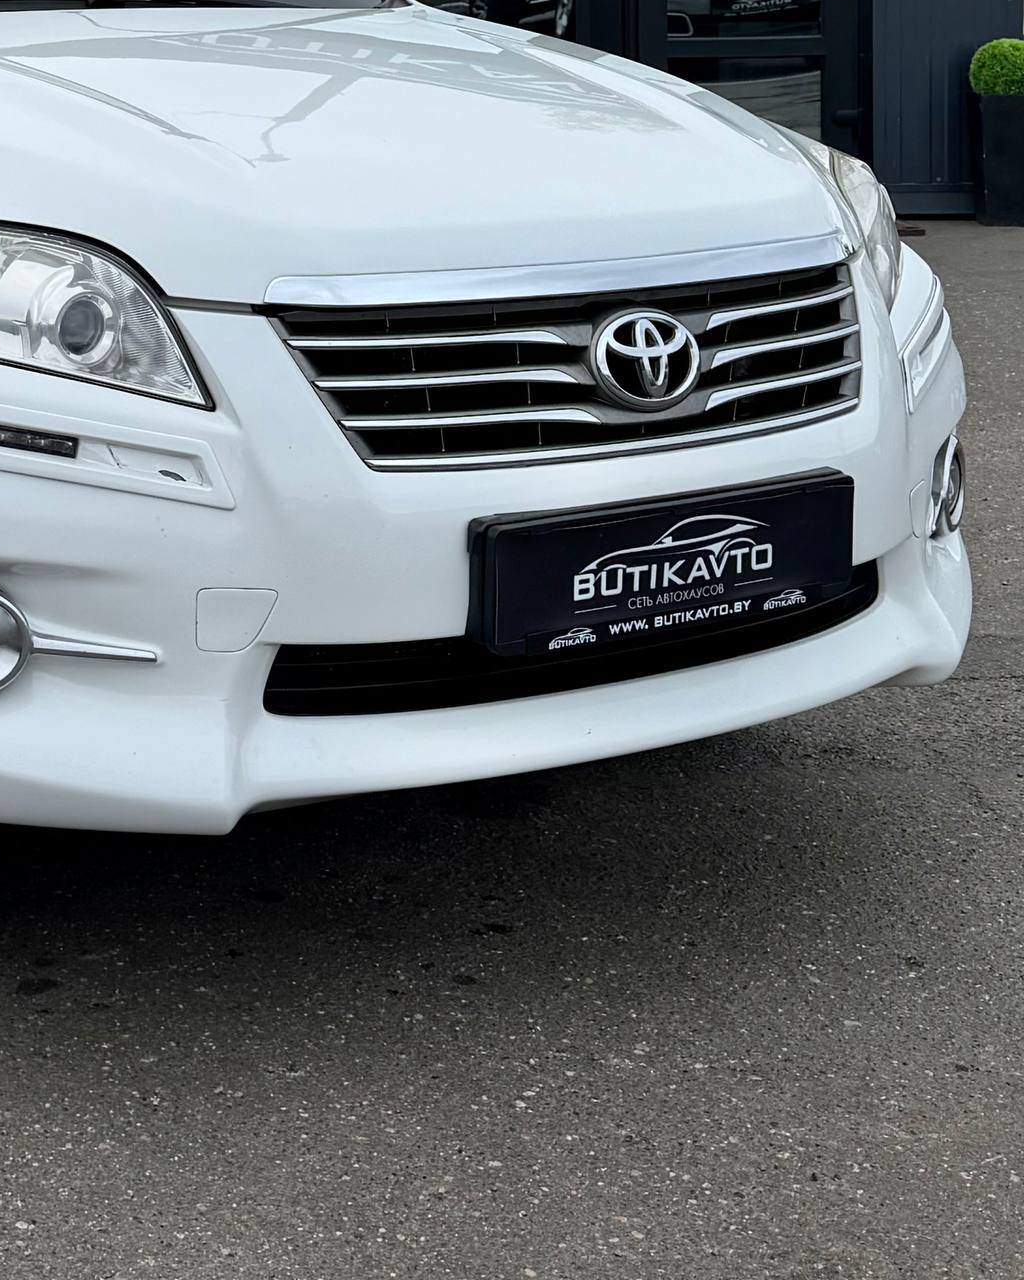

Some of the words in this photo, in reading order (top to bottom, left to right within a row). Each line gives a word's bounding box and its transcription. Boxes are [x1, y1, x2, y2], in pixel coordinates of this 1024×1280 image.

[573, 543, 773, 601] BUTIKAVTO
[628, 595, 653, 609] СЕТЬ
[656, 583, 725, 605] АВТОХАУСОВ
[764, 596, 806, 610] BUTIKAVTO
[609, 618, 649, 635] WWW.
[654, 599, 752, 627] BUTIKAVTO.BY
[549, 634, 596, 650] BUTIKAVTO
